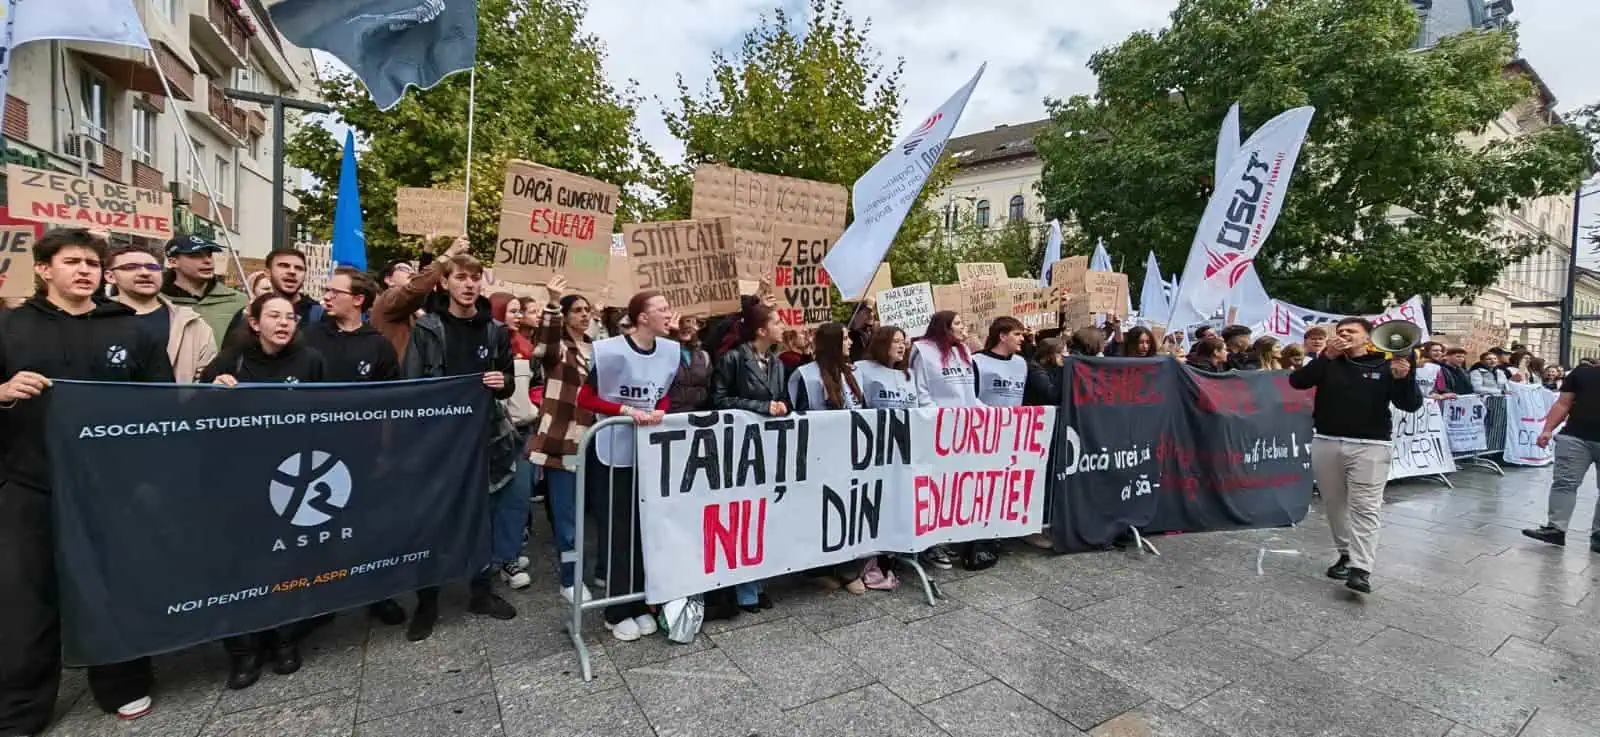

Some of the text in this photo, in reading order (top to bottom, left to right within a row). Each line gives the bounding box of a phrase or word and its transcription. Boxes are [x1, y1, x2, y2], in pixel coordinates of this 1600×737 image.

[21, 169, 94, 196] ZECI
[103, 183, 129, 200] DE
[513, 175, 614, 216] DACĂ GUVERNUL
[64, 193, 137, 214] DE VOCI
[1215, 151, 1271, 250] OSUT
[777, 237, 830, 266] ZECI
[775, 267, 792, 287] DE
[816, 267, 832, 287] DE
[785, 286, 830, 308] VOCI
[79, 404, 473, 439] ASOCIAȚIA STUDENȚILOR PSIHOLOGI DIN ROMÂNIA
[850, 408, 911, 471] DIN
[1114, 444, 1139, 469] vrei
[271, 527, 353, 552] ASPR
[703, 497, 767, 574] NU
[822, 478, 883, 553] DIN
[167, 599, 202, 615] NOI
[207, 586, 269, 607] PENTRU
[271, 577, 311, 593] ASPR,
[313, 569, 349, 585] ASPR
[350, 556, 399, 576] PENTRU
